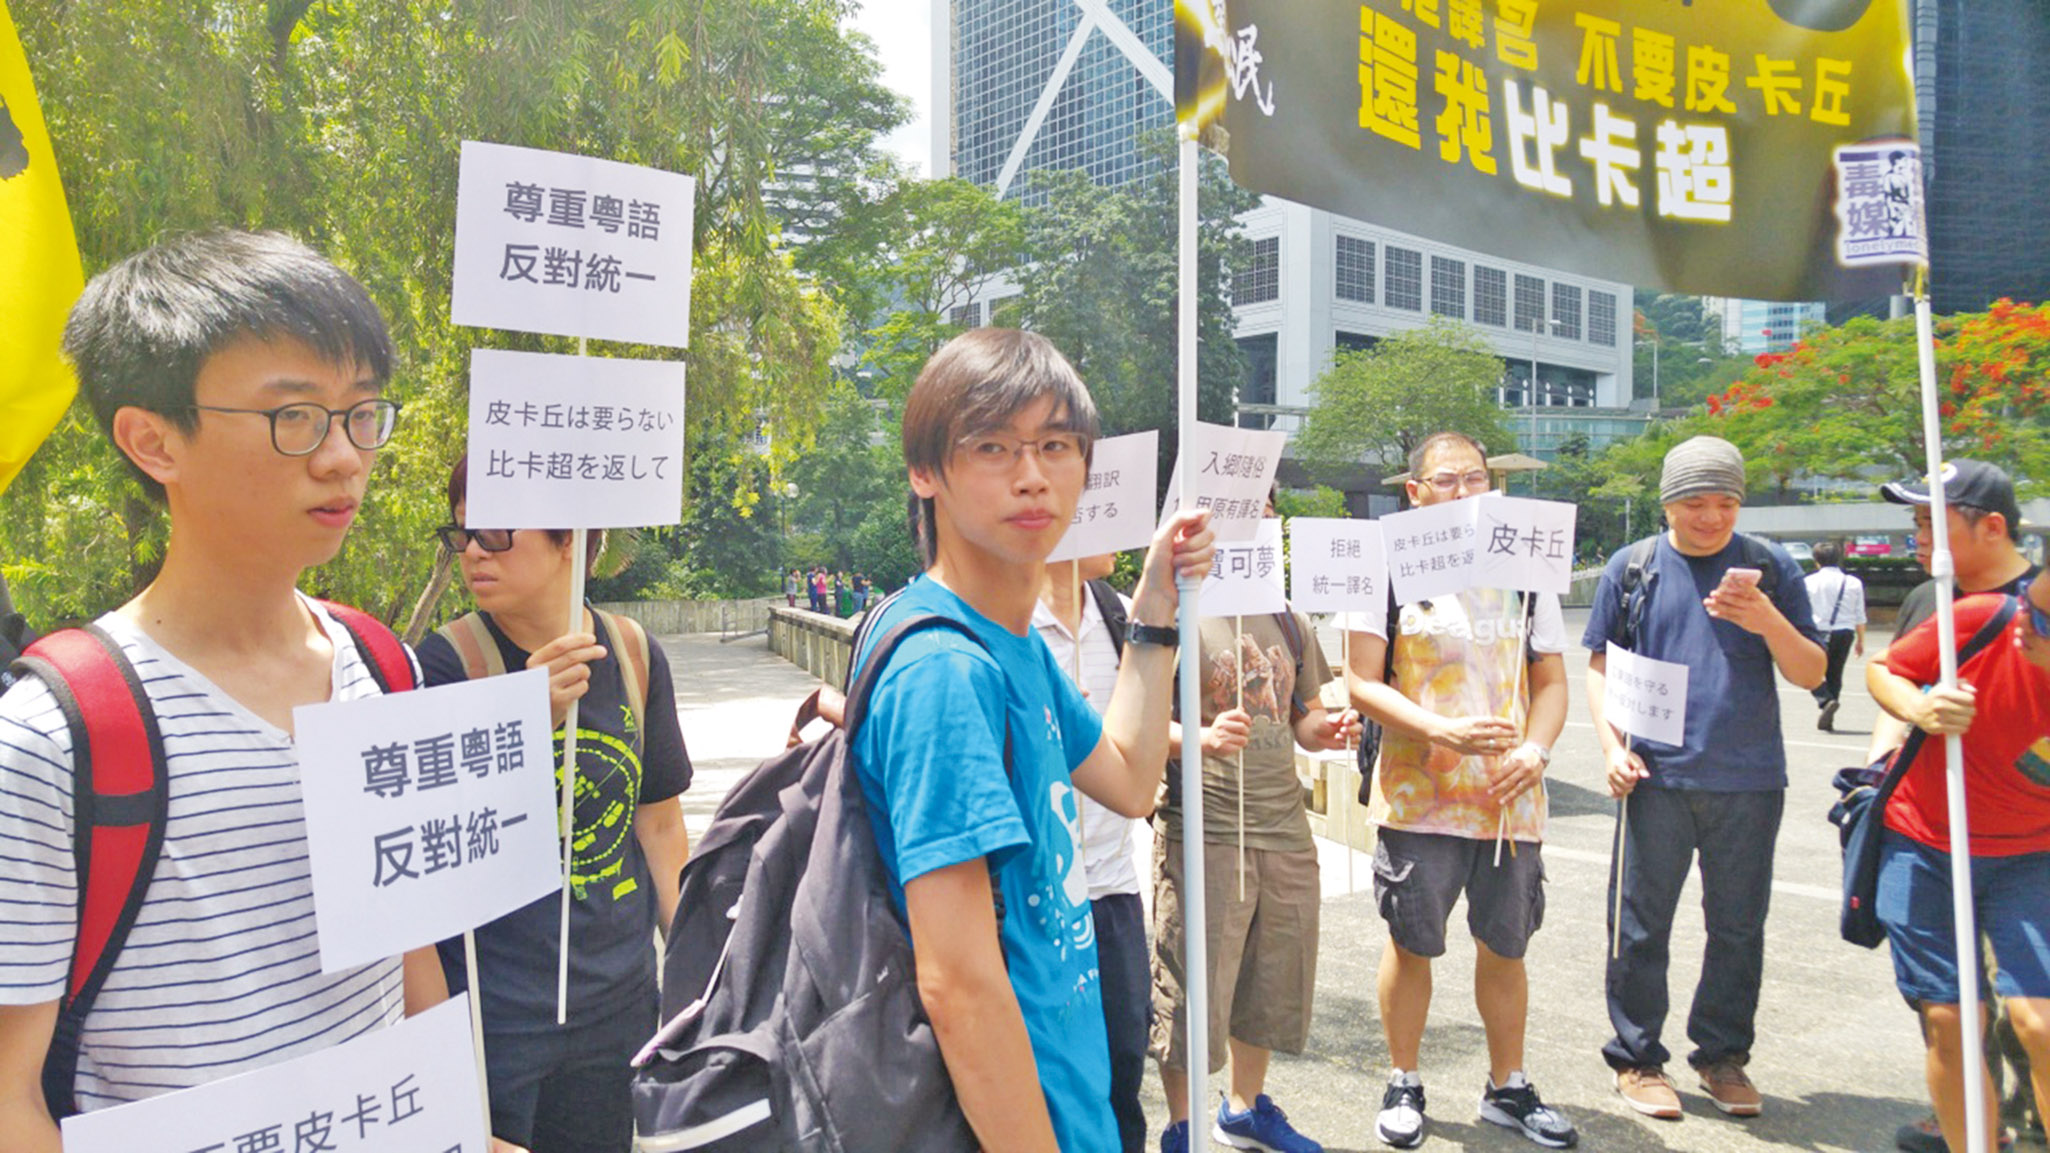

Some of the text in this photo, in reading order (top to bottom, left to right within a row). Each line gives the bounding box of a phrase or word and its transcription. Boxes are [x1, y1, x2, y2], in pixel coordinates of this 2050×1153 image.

[1575, 12, 1852, 126] 不要皮卡丘
[1358, 5, 1732, 221] 還我比卡超
[503, 181, 660, 241] 尊重粵語
[1845, 164, 1889, 236] 毒媒
[500, 244, 656, 293] 反對統一
[485, 400, 674, 432] 皮卡丘は要らない
[486, 449, 669, 480] 比卡超を返して
[1331, 538, 1361, 558] 拒絕
[1394, 524, 1475, 551] 皮卡丘は要ら
[1487, 523, 1565, 558] 皮卡丘
[1313, 575, 1373, 595] 統一譯名
[361, 720, 524, 798] 尊重粵語
[373, 807, 528, 887] 反對統一
[186, 1073, 423, 1153] 要皮卡丘
